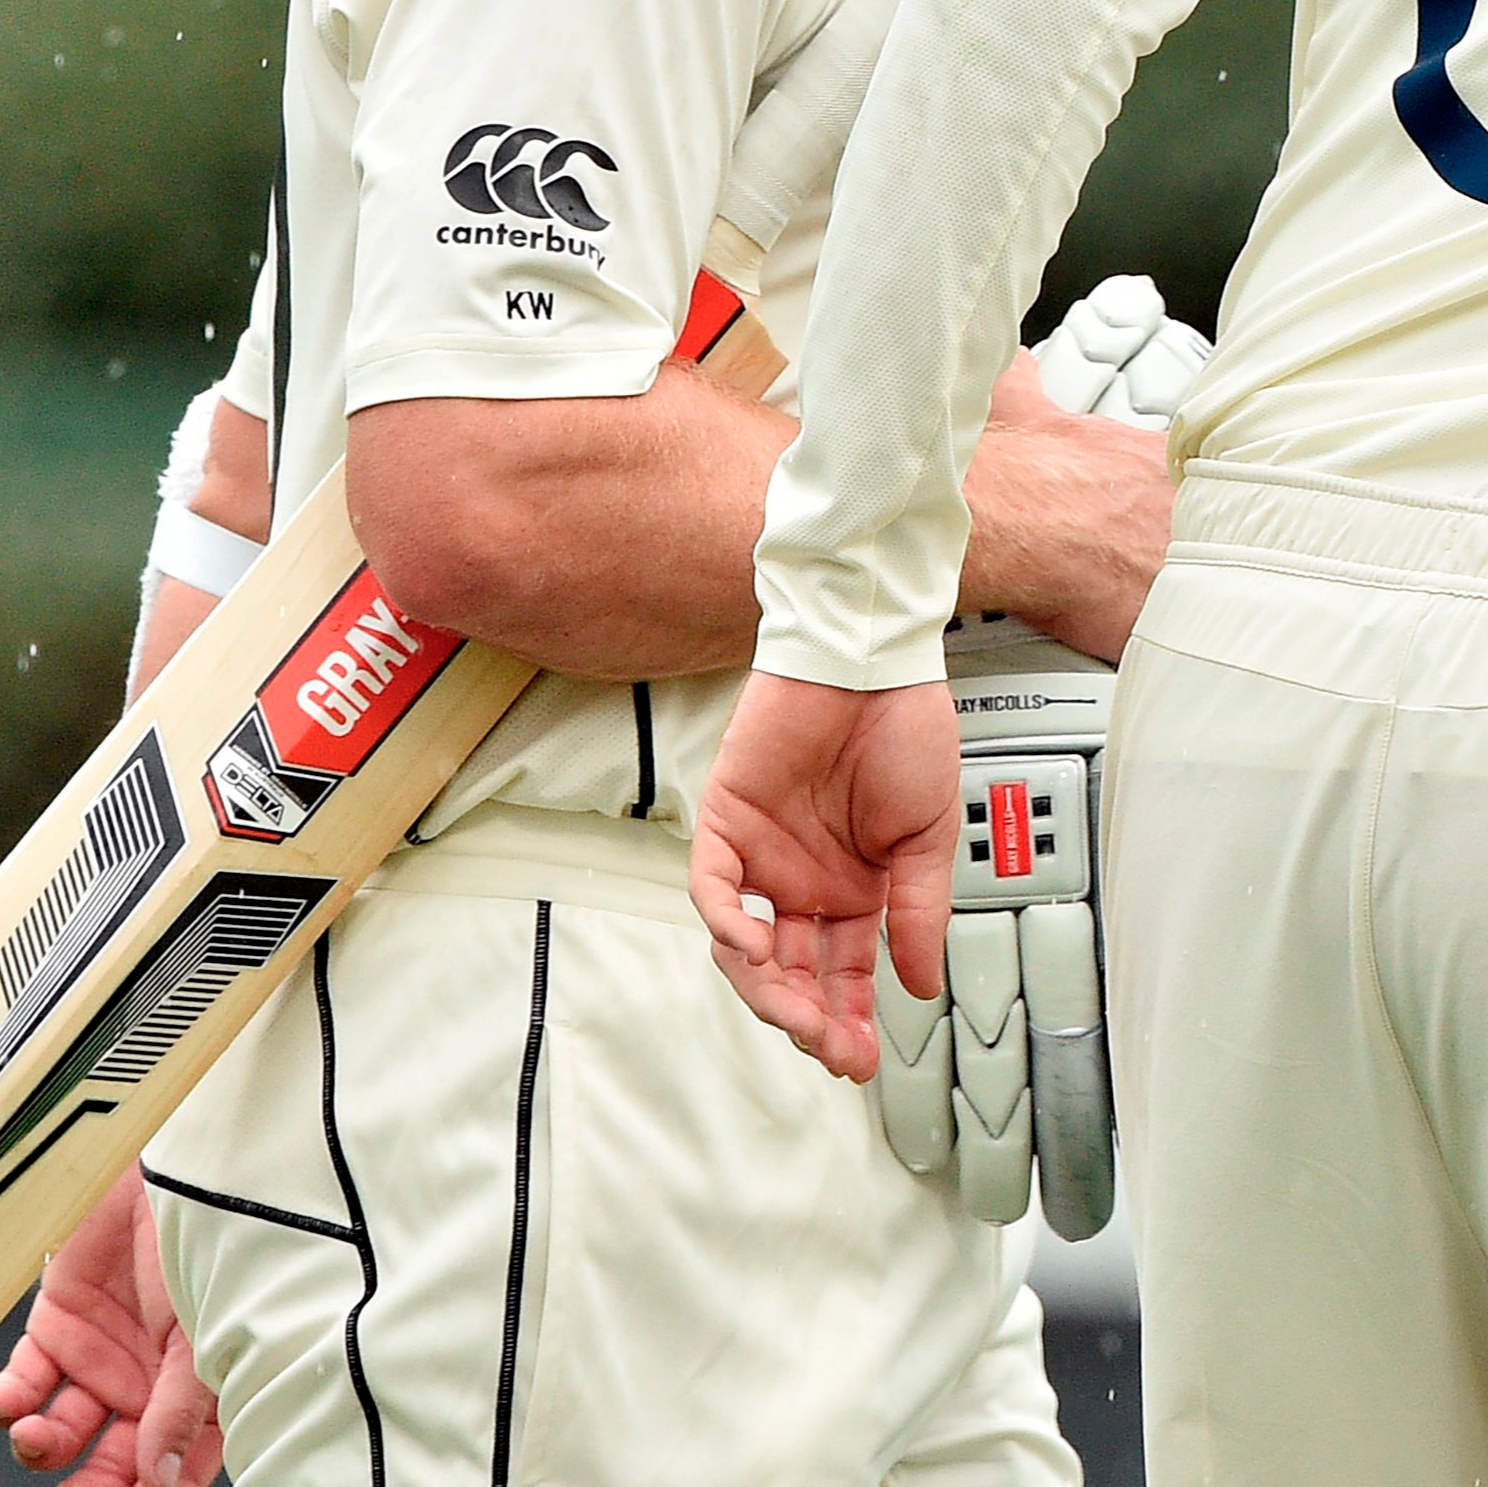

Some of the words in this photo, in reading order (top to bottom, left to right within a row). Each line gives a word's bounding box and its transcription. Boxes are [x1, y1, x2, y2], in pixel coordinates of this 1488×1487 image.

[435, 222, 607, 272] canterbury
[505, 289, 555, 320] KW
[219, 762, 285, 826] DELTA
